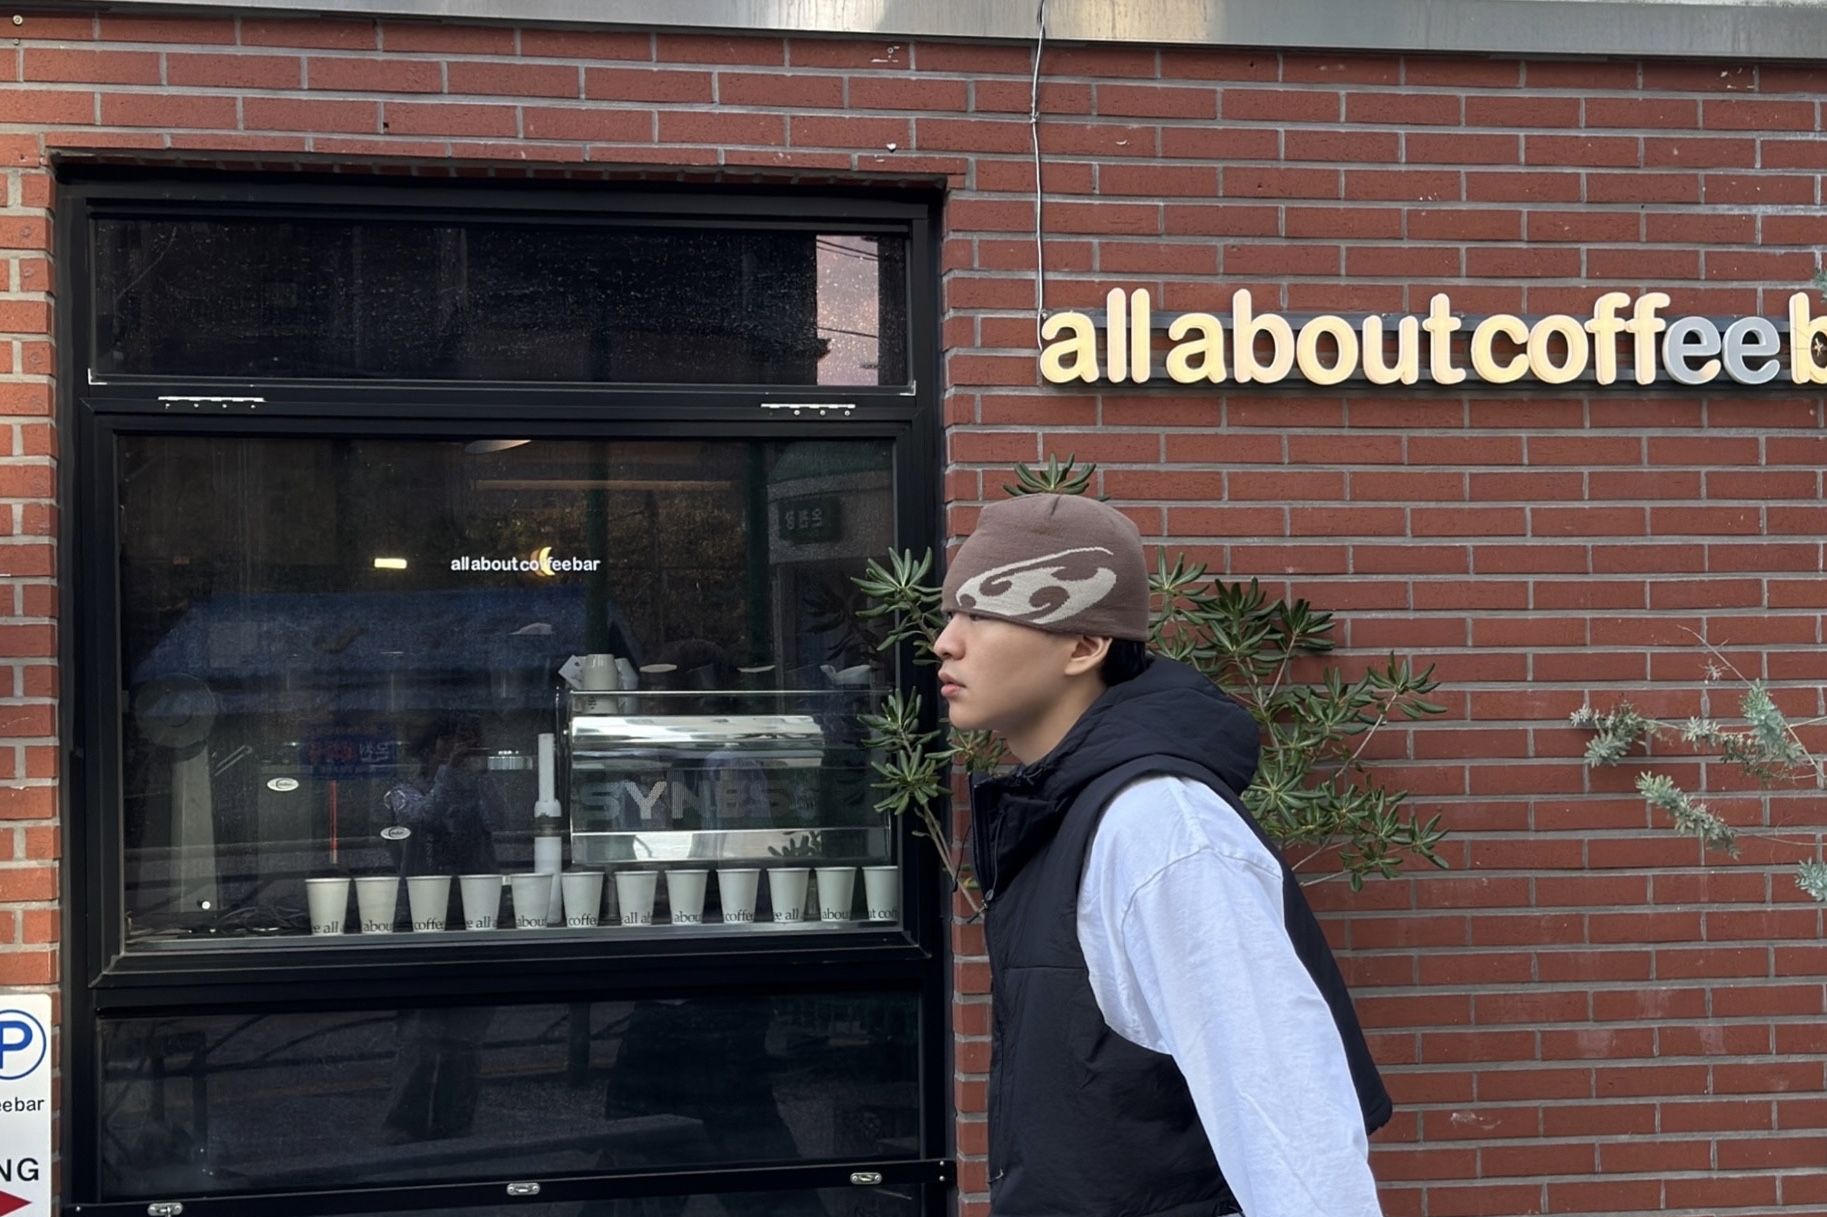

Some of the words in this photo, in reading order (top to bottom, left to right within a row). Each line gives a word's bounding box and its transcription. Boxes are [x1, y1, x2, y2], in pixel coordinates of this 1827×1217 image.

[1039, 287, 1151, 384] all
[623, 911, 638, 924] all
[784, 907, 799, 920] all
[323, 920, 339, 934] all
[475, 915, 491, 929] all
[0, 1097, 45, 1112] ebar
